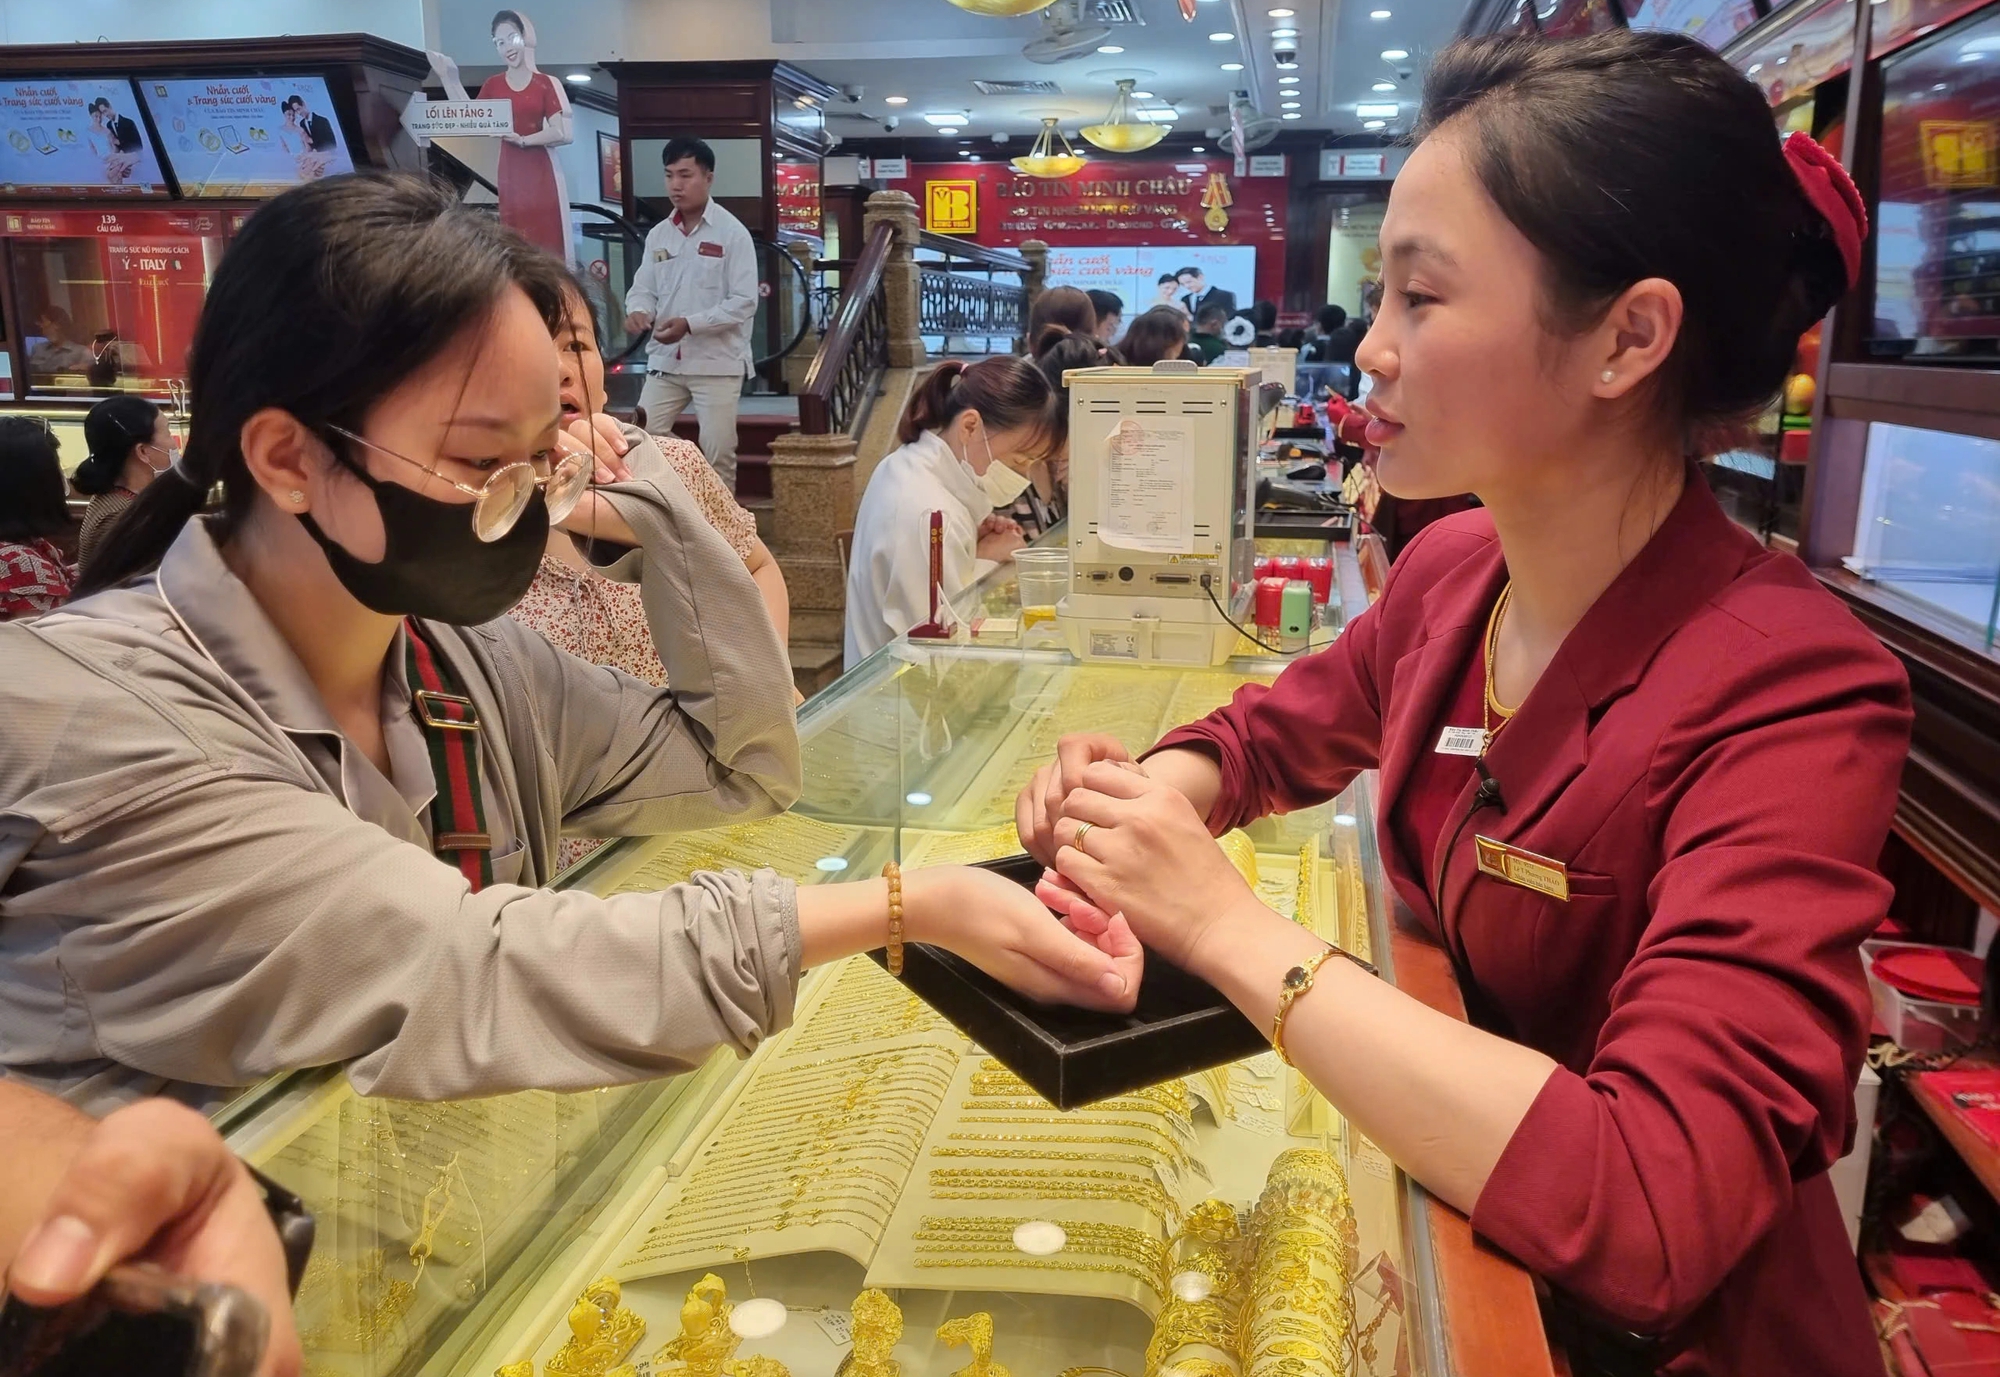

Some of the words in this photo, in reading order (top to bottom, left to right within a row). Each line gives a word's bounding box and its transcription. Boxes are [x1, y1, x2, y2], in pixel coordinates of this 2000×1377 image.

[40, 87, 57, 96] cưới
[206, 84, 230, 95] Nhẫn
[232, 84, 250, 94] cưới
[3, 97, 27, 108] Trang
[29, 97, 42, 106] sức
[44, 97, 61, 106] cưới
[63, 97, 84, 107] vàng
[193, 96, 218, 106] Trang
[220, 95, 234, 104] sức
[236, 94, 253, 104] cưới
[255, 94, 276, 105] vàng
[426, 105, 439, 119] LỐI
[443, 106, 457, 118] LÊN
[487, 108, 493, 117] 2
[1078, 180, 1130, 198] MINH
[1135, 174, 1191, 196] CHÂU
[101, 215, 116, 224] 139
[110, 224, 124, 233] GIẤY
[173, 246, 190, 254] CÁCH
[140, 258, 167, 270] ITALY
[1115, 264, 1154, 276] vàng
